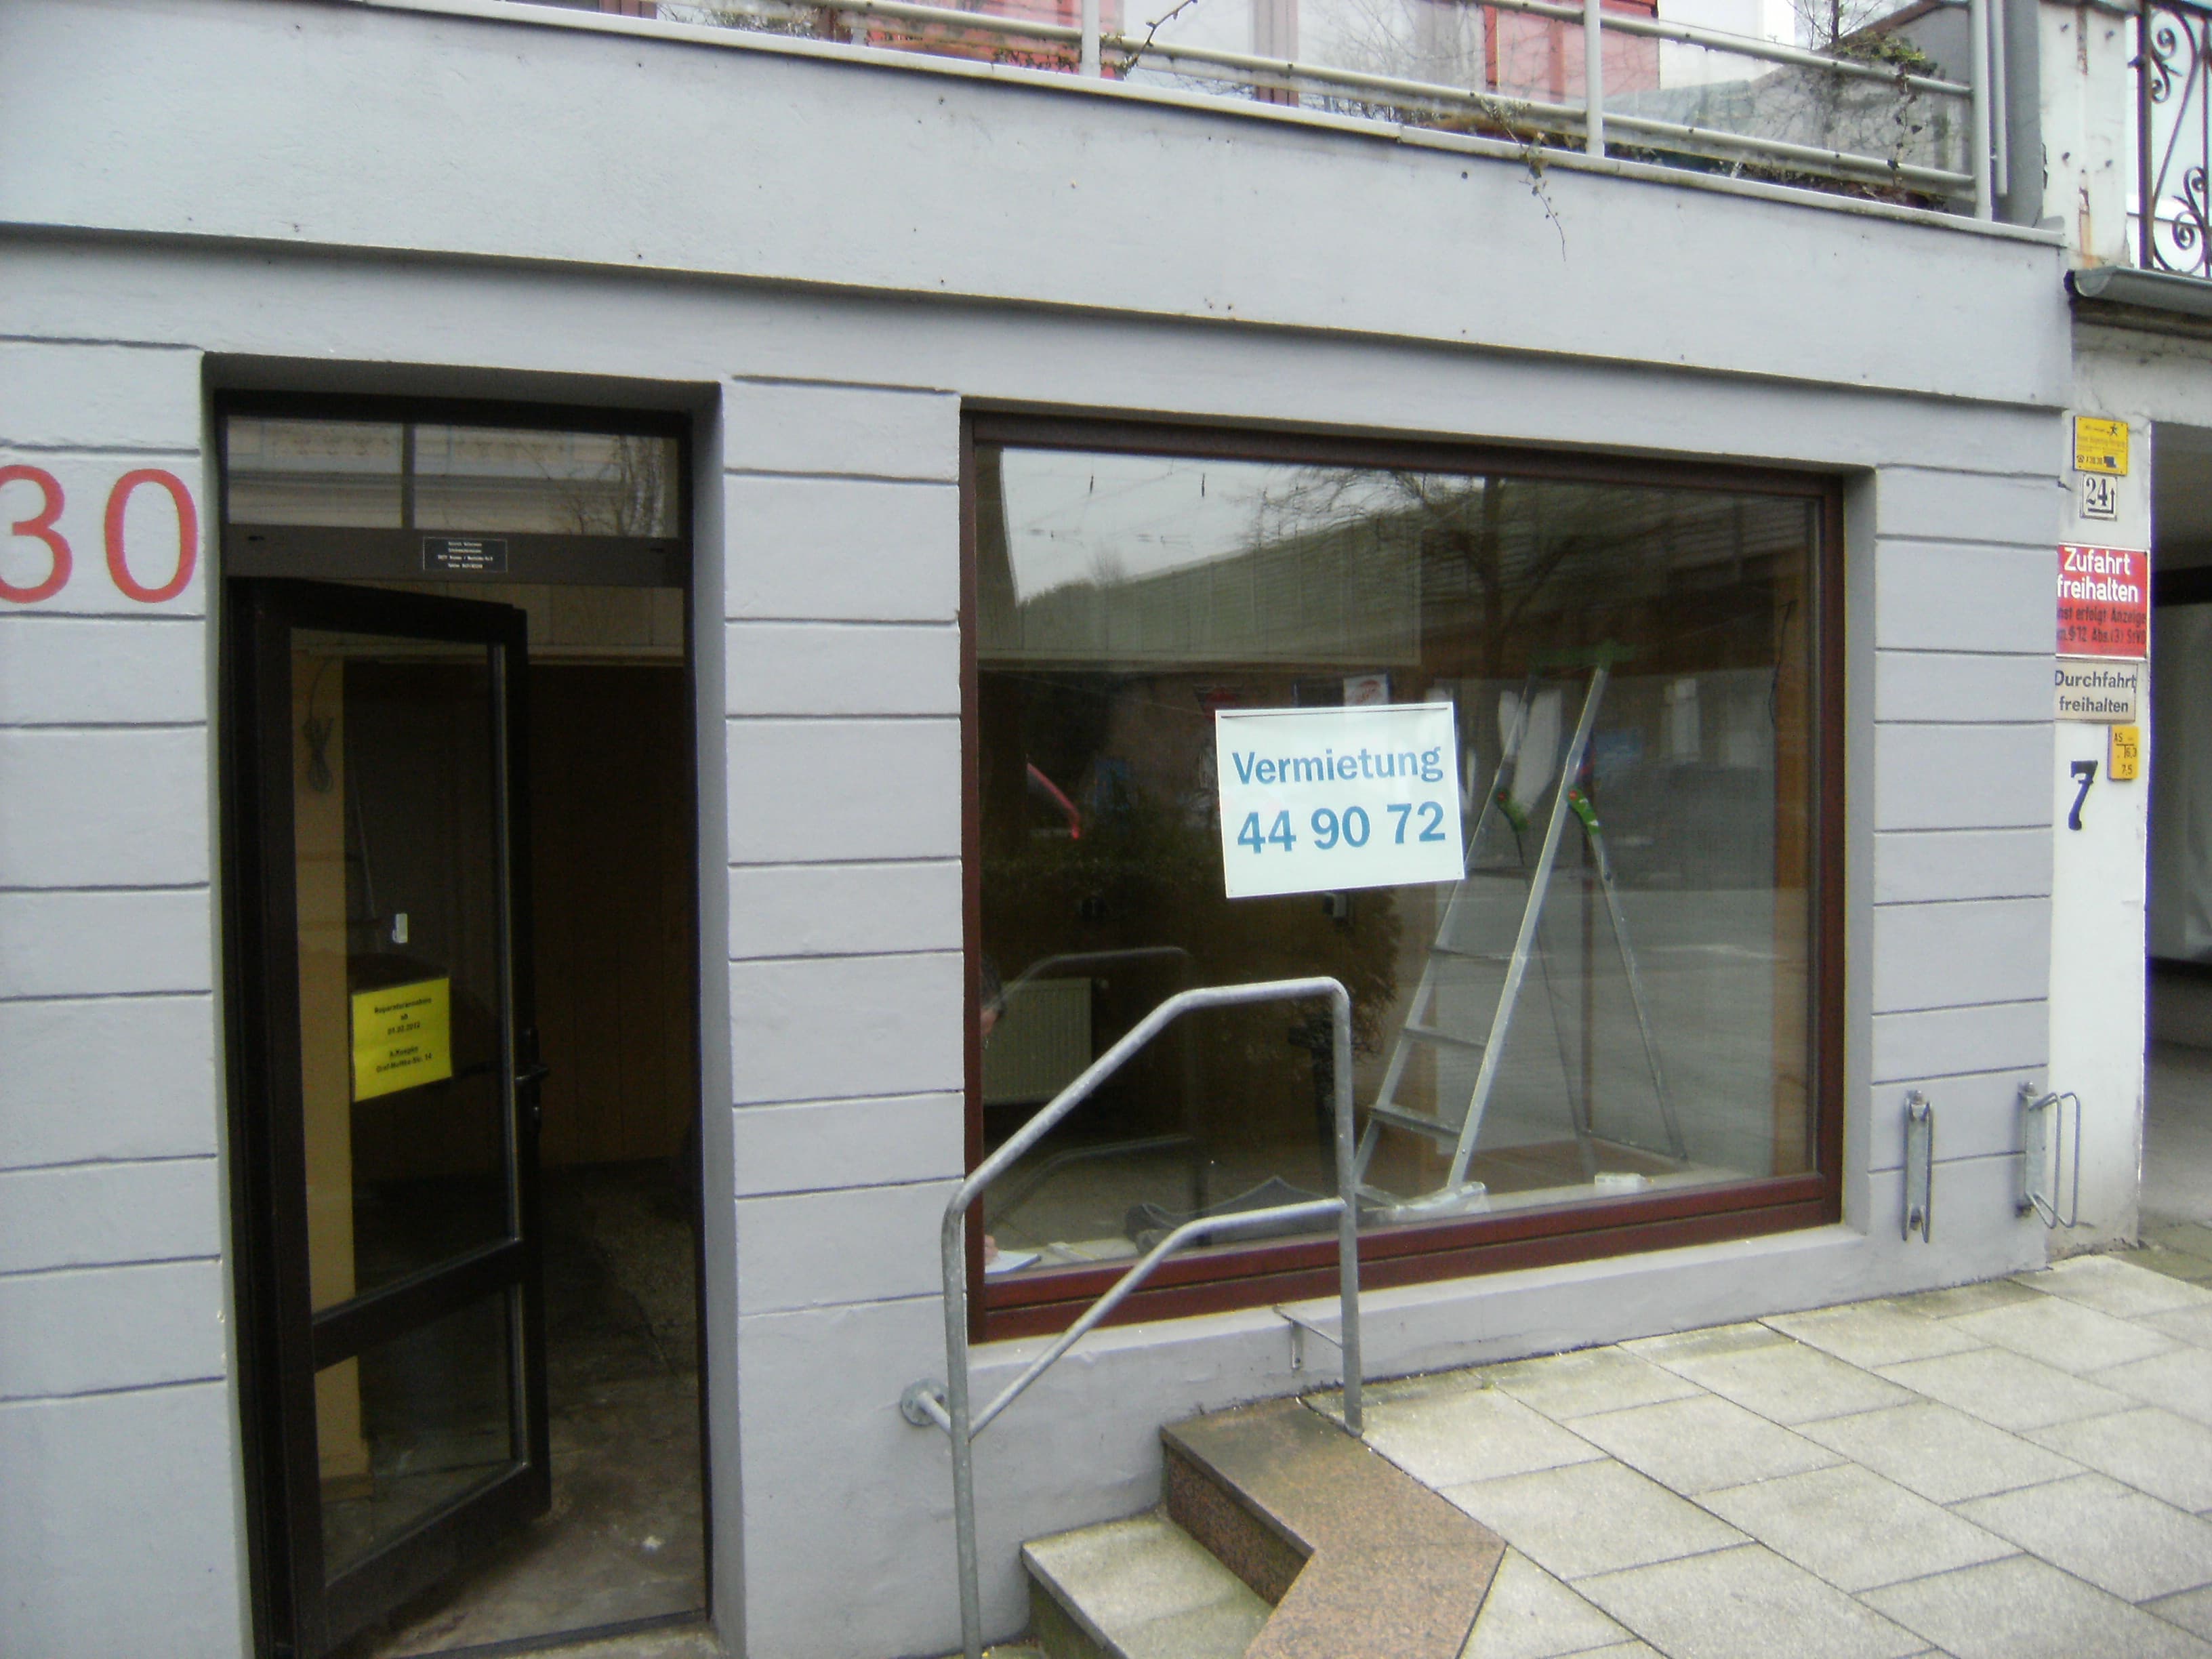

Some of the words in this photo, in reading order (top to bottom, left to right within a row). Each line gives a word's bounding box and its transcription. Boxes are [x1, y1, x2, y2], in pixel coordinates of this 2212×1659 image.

[2086, 477, 2108, 506] 24
[0, 464, 198, 603] 30
[2064, 547, 2131, 575] Zufahrt
[2057, 573, 2138, 602] freihalten
[2055, 670, 2136, 689] Durchfahrt
[2060, 696, 2129, 713] freihalten
[1232, 746, 1443, 785] Vermietung
[2068, 760, 2098, 831] 7
[1237, 810, 1296, 854] 44
[1311, 806, 1370, 851] 90
[1387, 801, 1446, 844] 72
